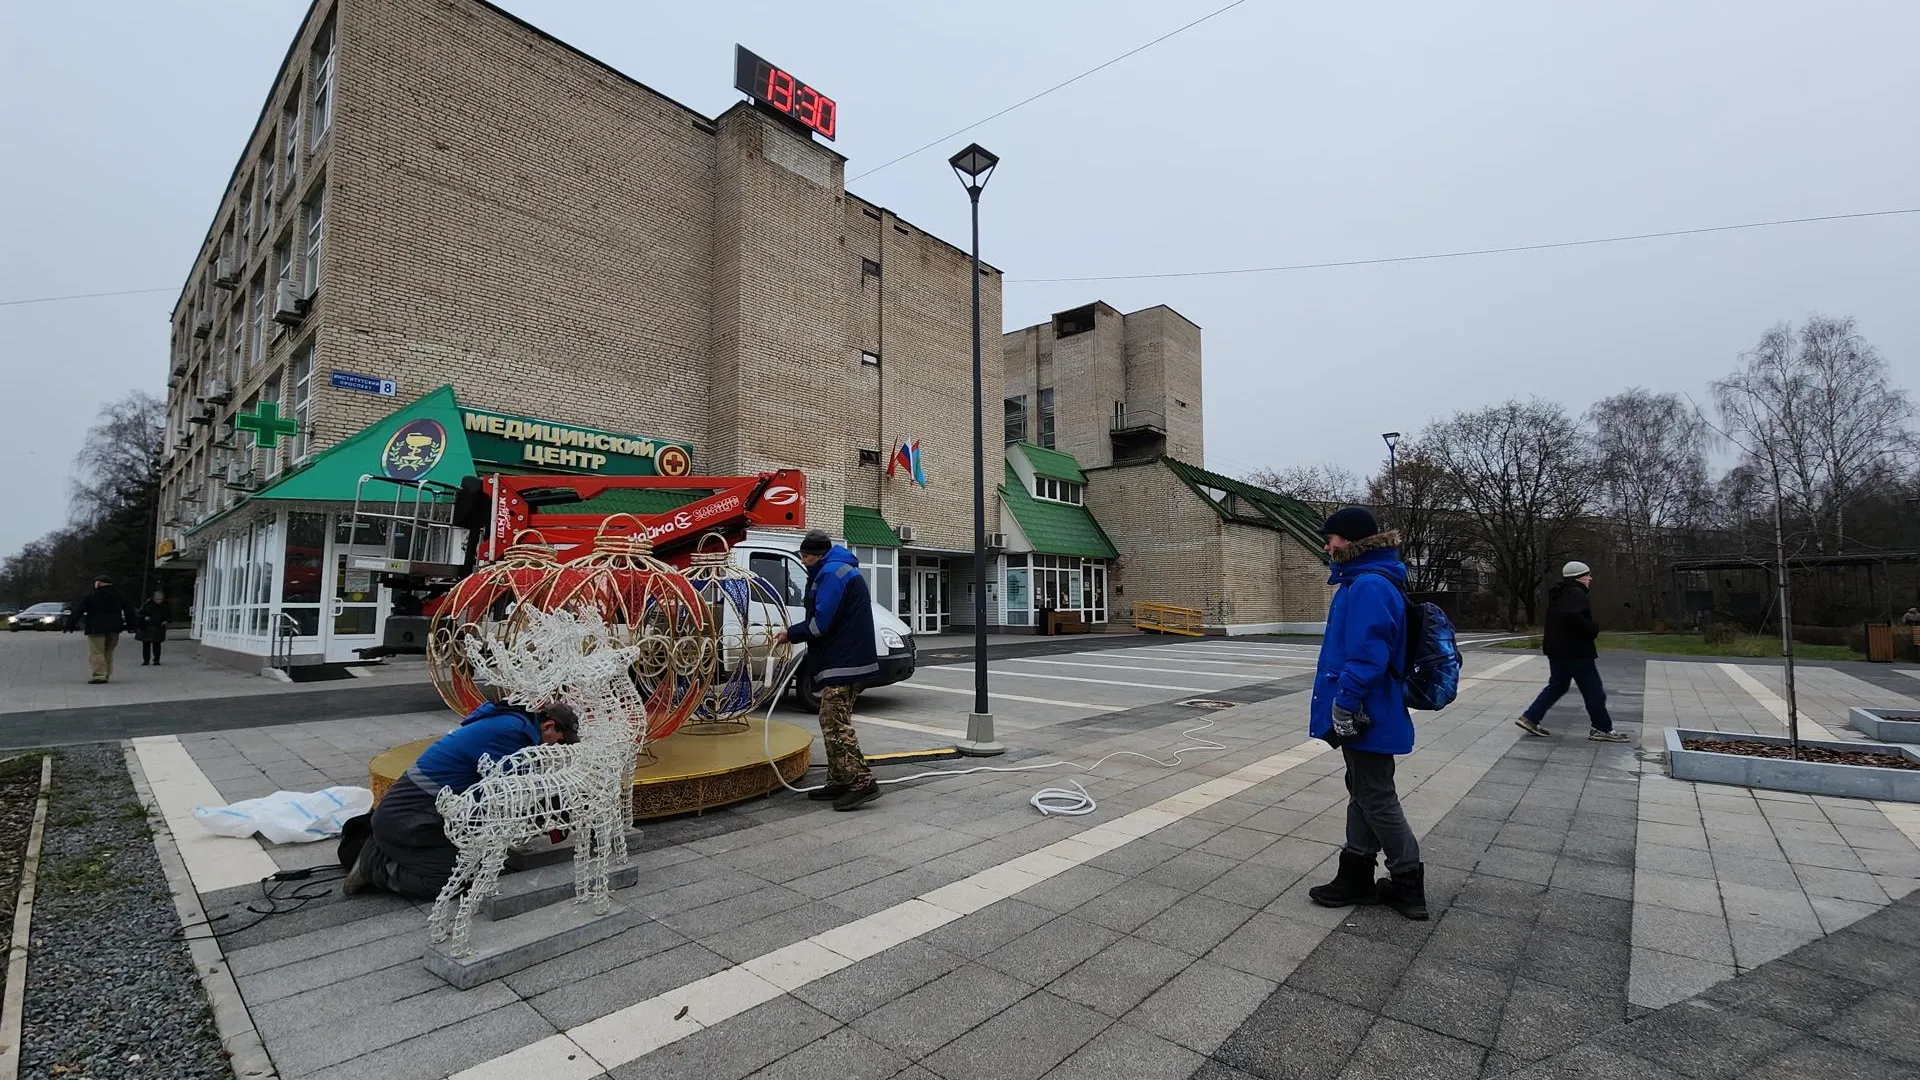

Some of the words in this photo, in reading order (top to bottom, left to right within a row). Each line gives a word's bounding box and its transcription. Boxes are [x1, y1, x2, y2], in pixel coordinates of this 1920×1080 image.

[767, 68, 837, 136] 13:30
[333, 374, 380, 387] ИНСТИТУТСКИЙ
[340, 380, 372, 390] ПРОСПЕКТ
[384, 382, 392, 394] 8
[465, 412, 655, 458] МЕДИЦИНСКИЙ
[523, 444, 607, 470] ЦЕНТР
